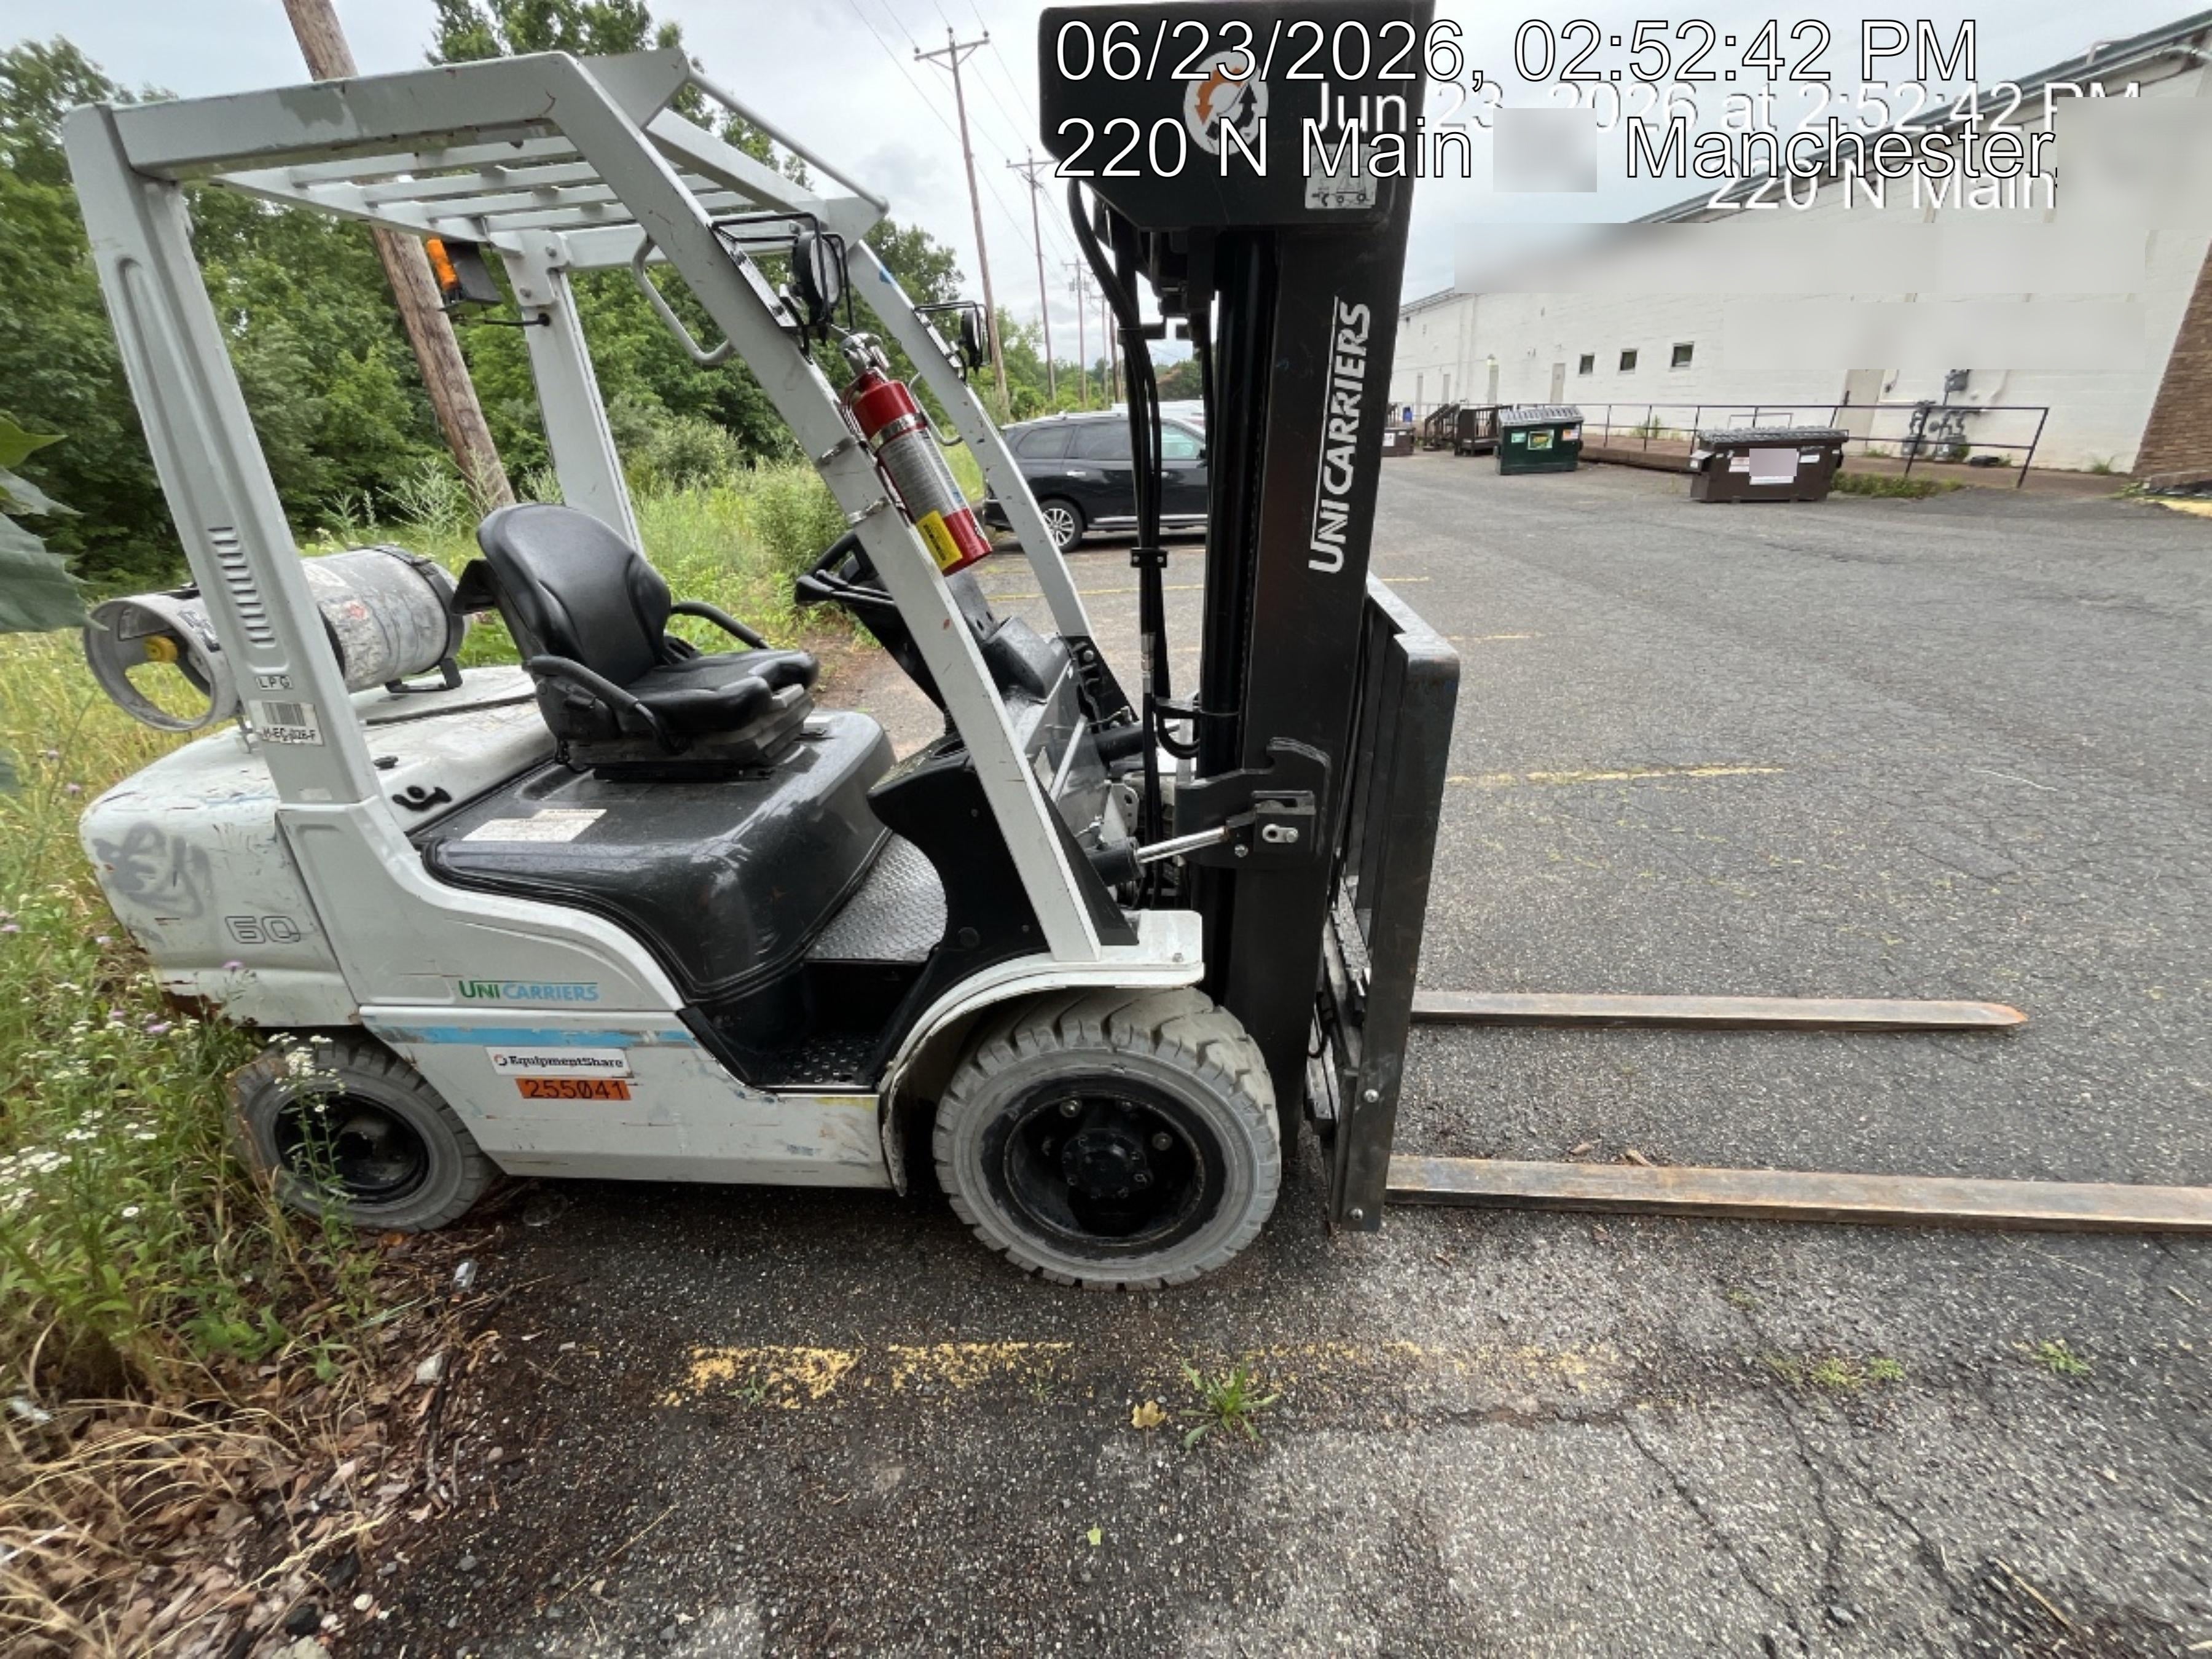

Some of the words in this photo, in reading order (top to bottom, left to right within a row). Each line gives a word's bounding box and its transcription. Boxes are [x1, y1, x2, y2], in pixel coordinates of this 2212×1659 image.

[1308, 296, 1370, 573] UNICARRIERS
[458, 980, 599, 1001] UNICARRIERS
[508, 1055, 624, 1068] EquipmentShare
[525, 1079, 624, 1100] 255041
